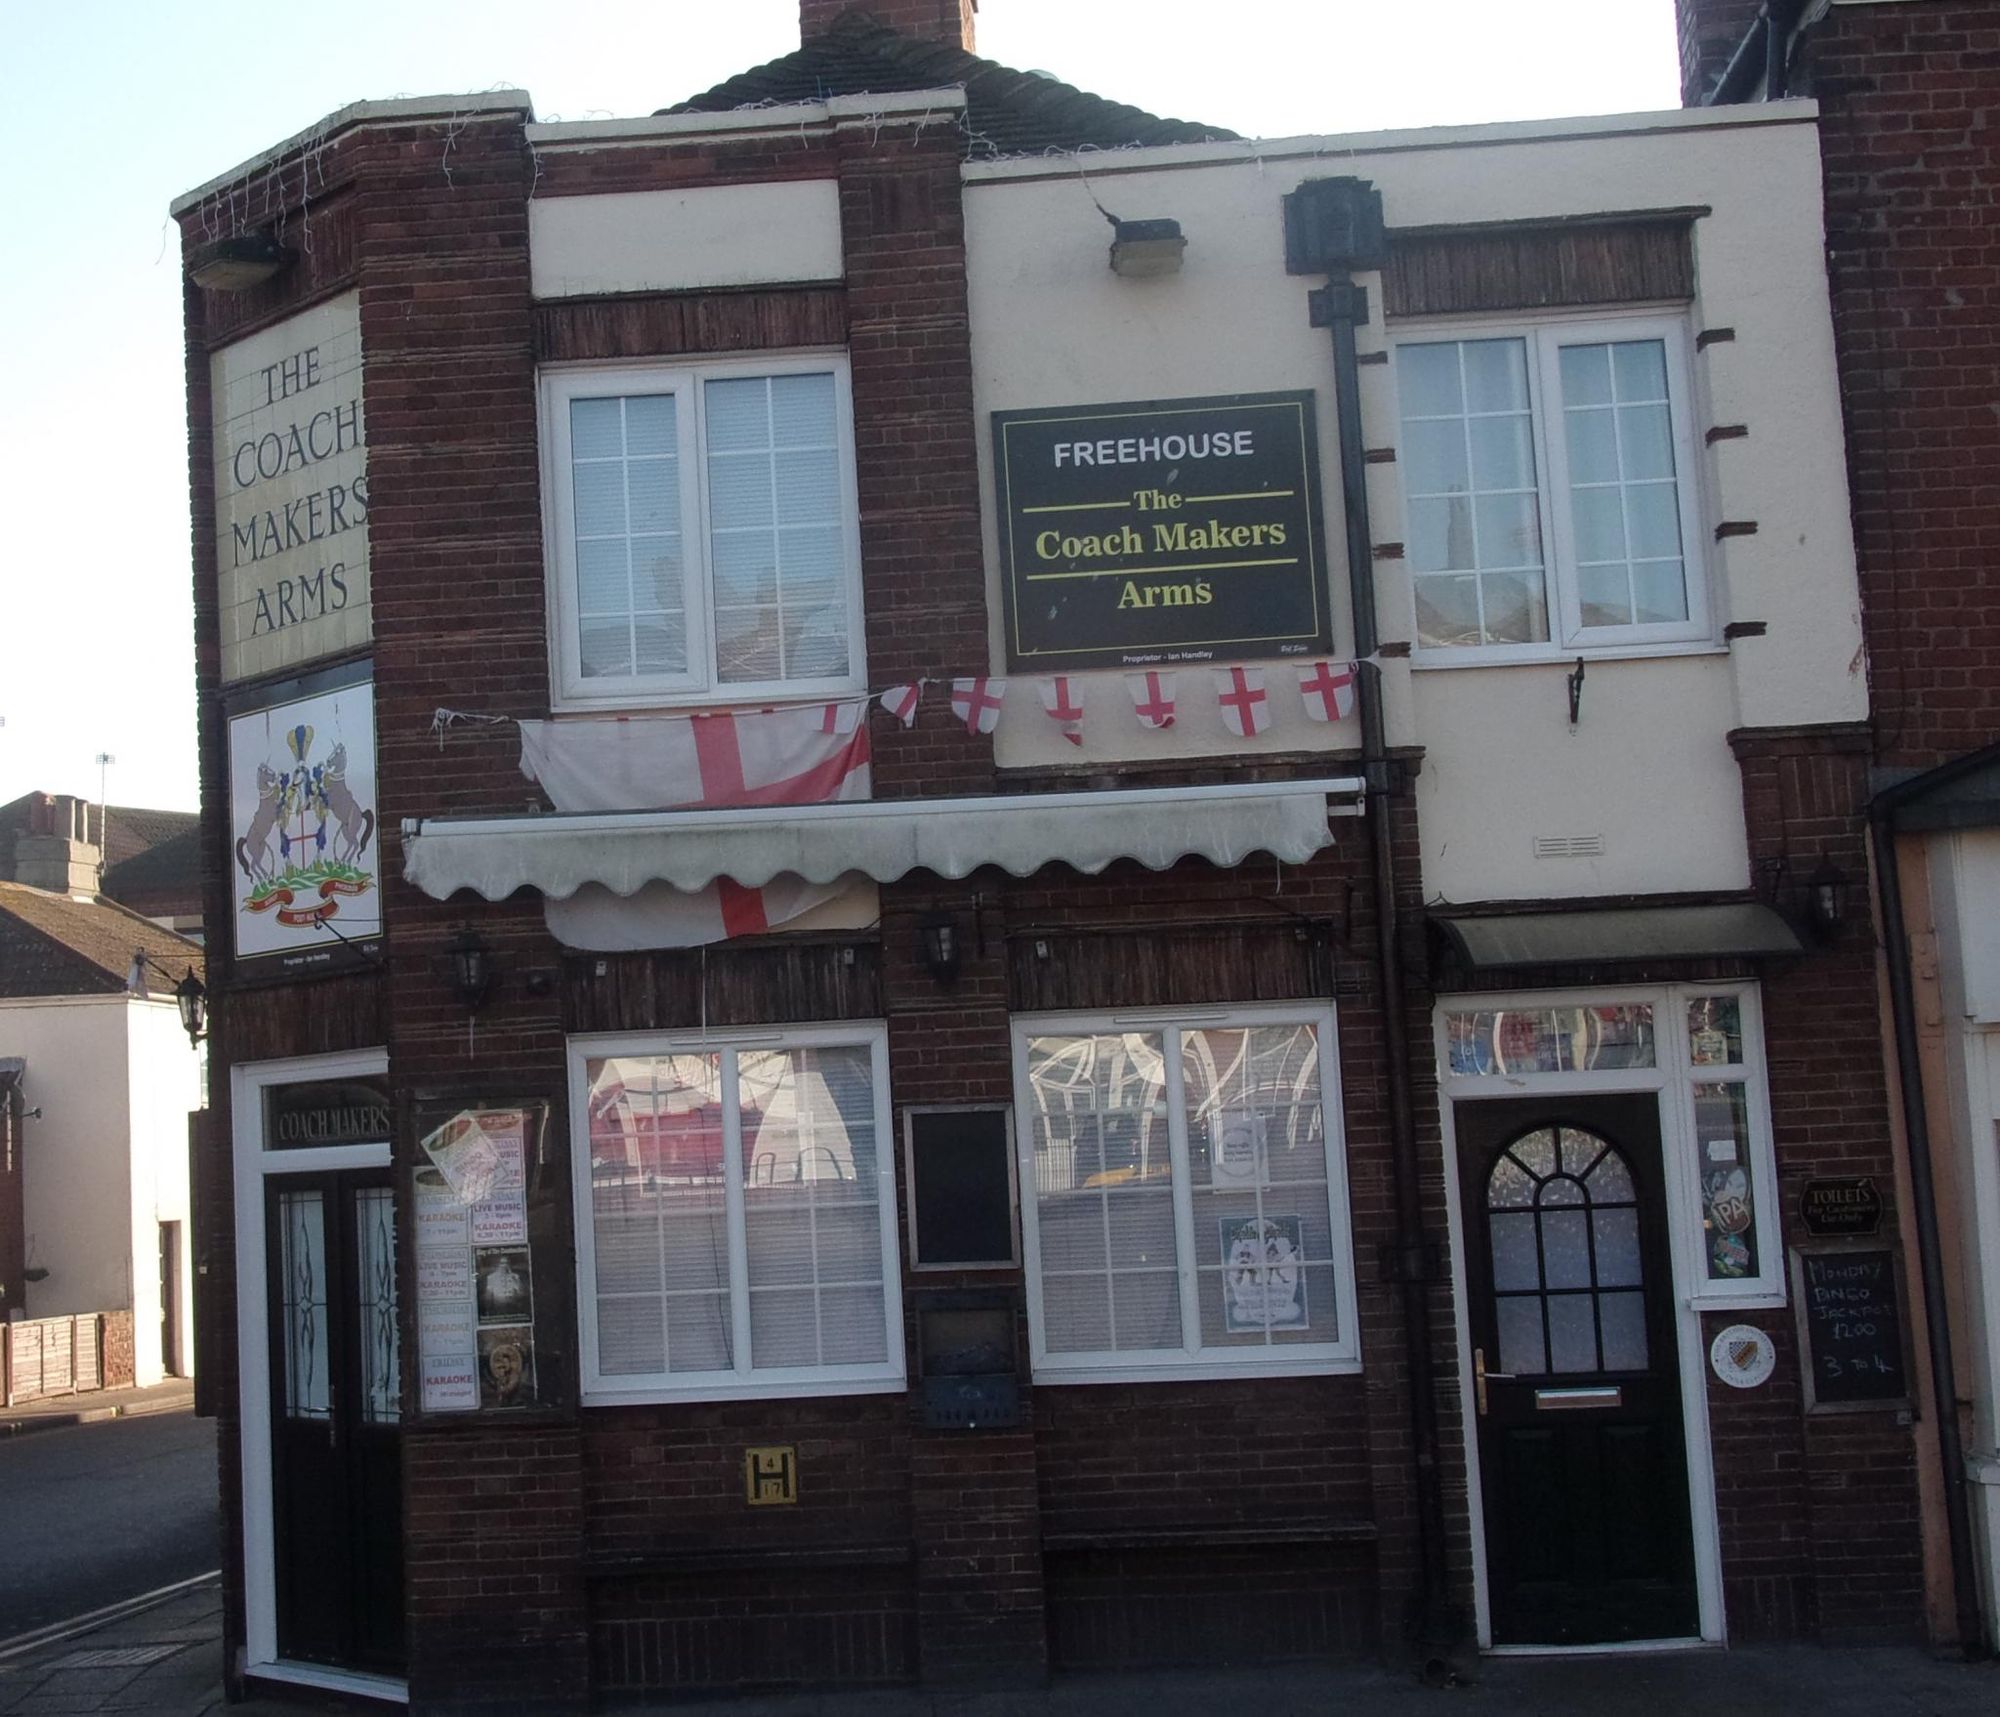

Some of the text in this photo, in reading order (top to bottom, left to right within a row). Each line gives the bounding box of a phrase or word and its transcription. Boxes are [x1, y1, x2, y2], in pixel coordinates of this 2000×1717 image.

[261, 347, 321, 405] THE
[234, 399, 361, 487] COACH
[1054, 430, 1255, 468] FREEHOUSE
[1134, 489, 1183, 512] The
[231, 477, 369, 567] MAKERS
[1036, 520, 1287, 560] Coach Makers
[251, 563, 348, 636] ARMS
[1117, 581, 1213, 609] Arms
[279, 1109, 328, 1140] COACH
[474, 1203, 521, 1213] LIVE MUSIC
[1810, 1188, 1871, 1204] TOILETS
[1711, 1196, 1748, 1225] IPA
[474, 1221, 522, 1232] KARAOKE
[1814, 1287, 1871, 1303] BINGO
[1814, 1304, 1892, 1320] JACKPOT
[1823, 1356, 1843, 1378] 3
[1874, 1352, 1895, 1373] 4
[426, 1374, 474, 1386] KARAOKE
[752, 1452, 790, 1499] H
